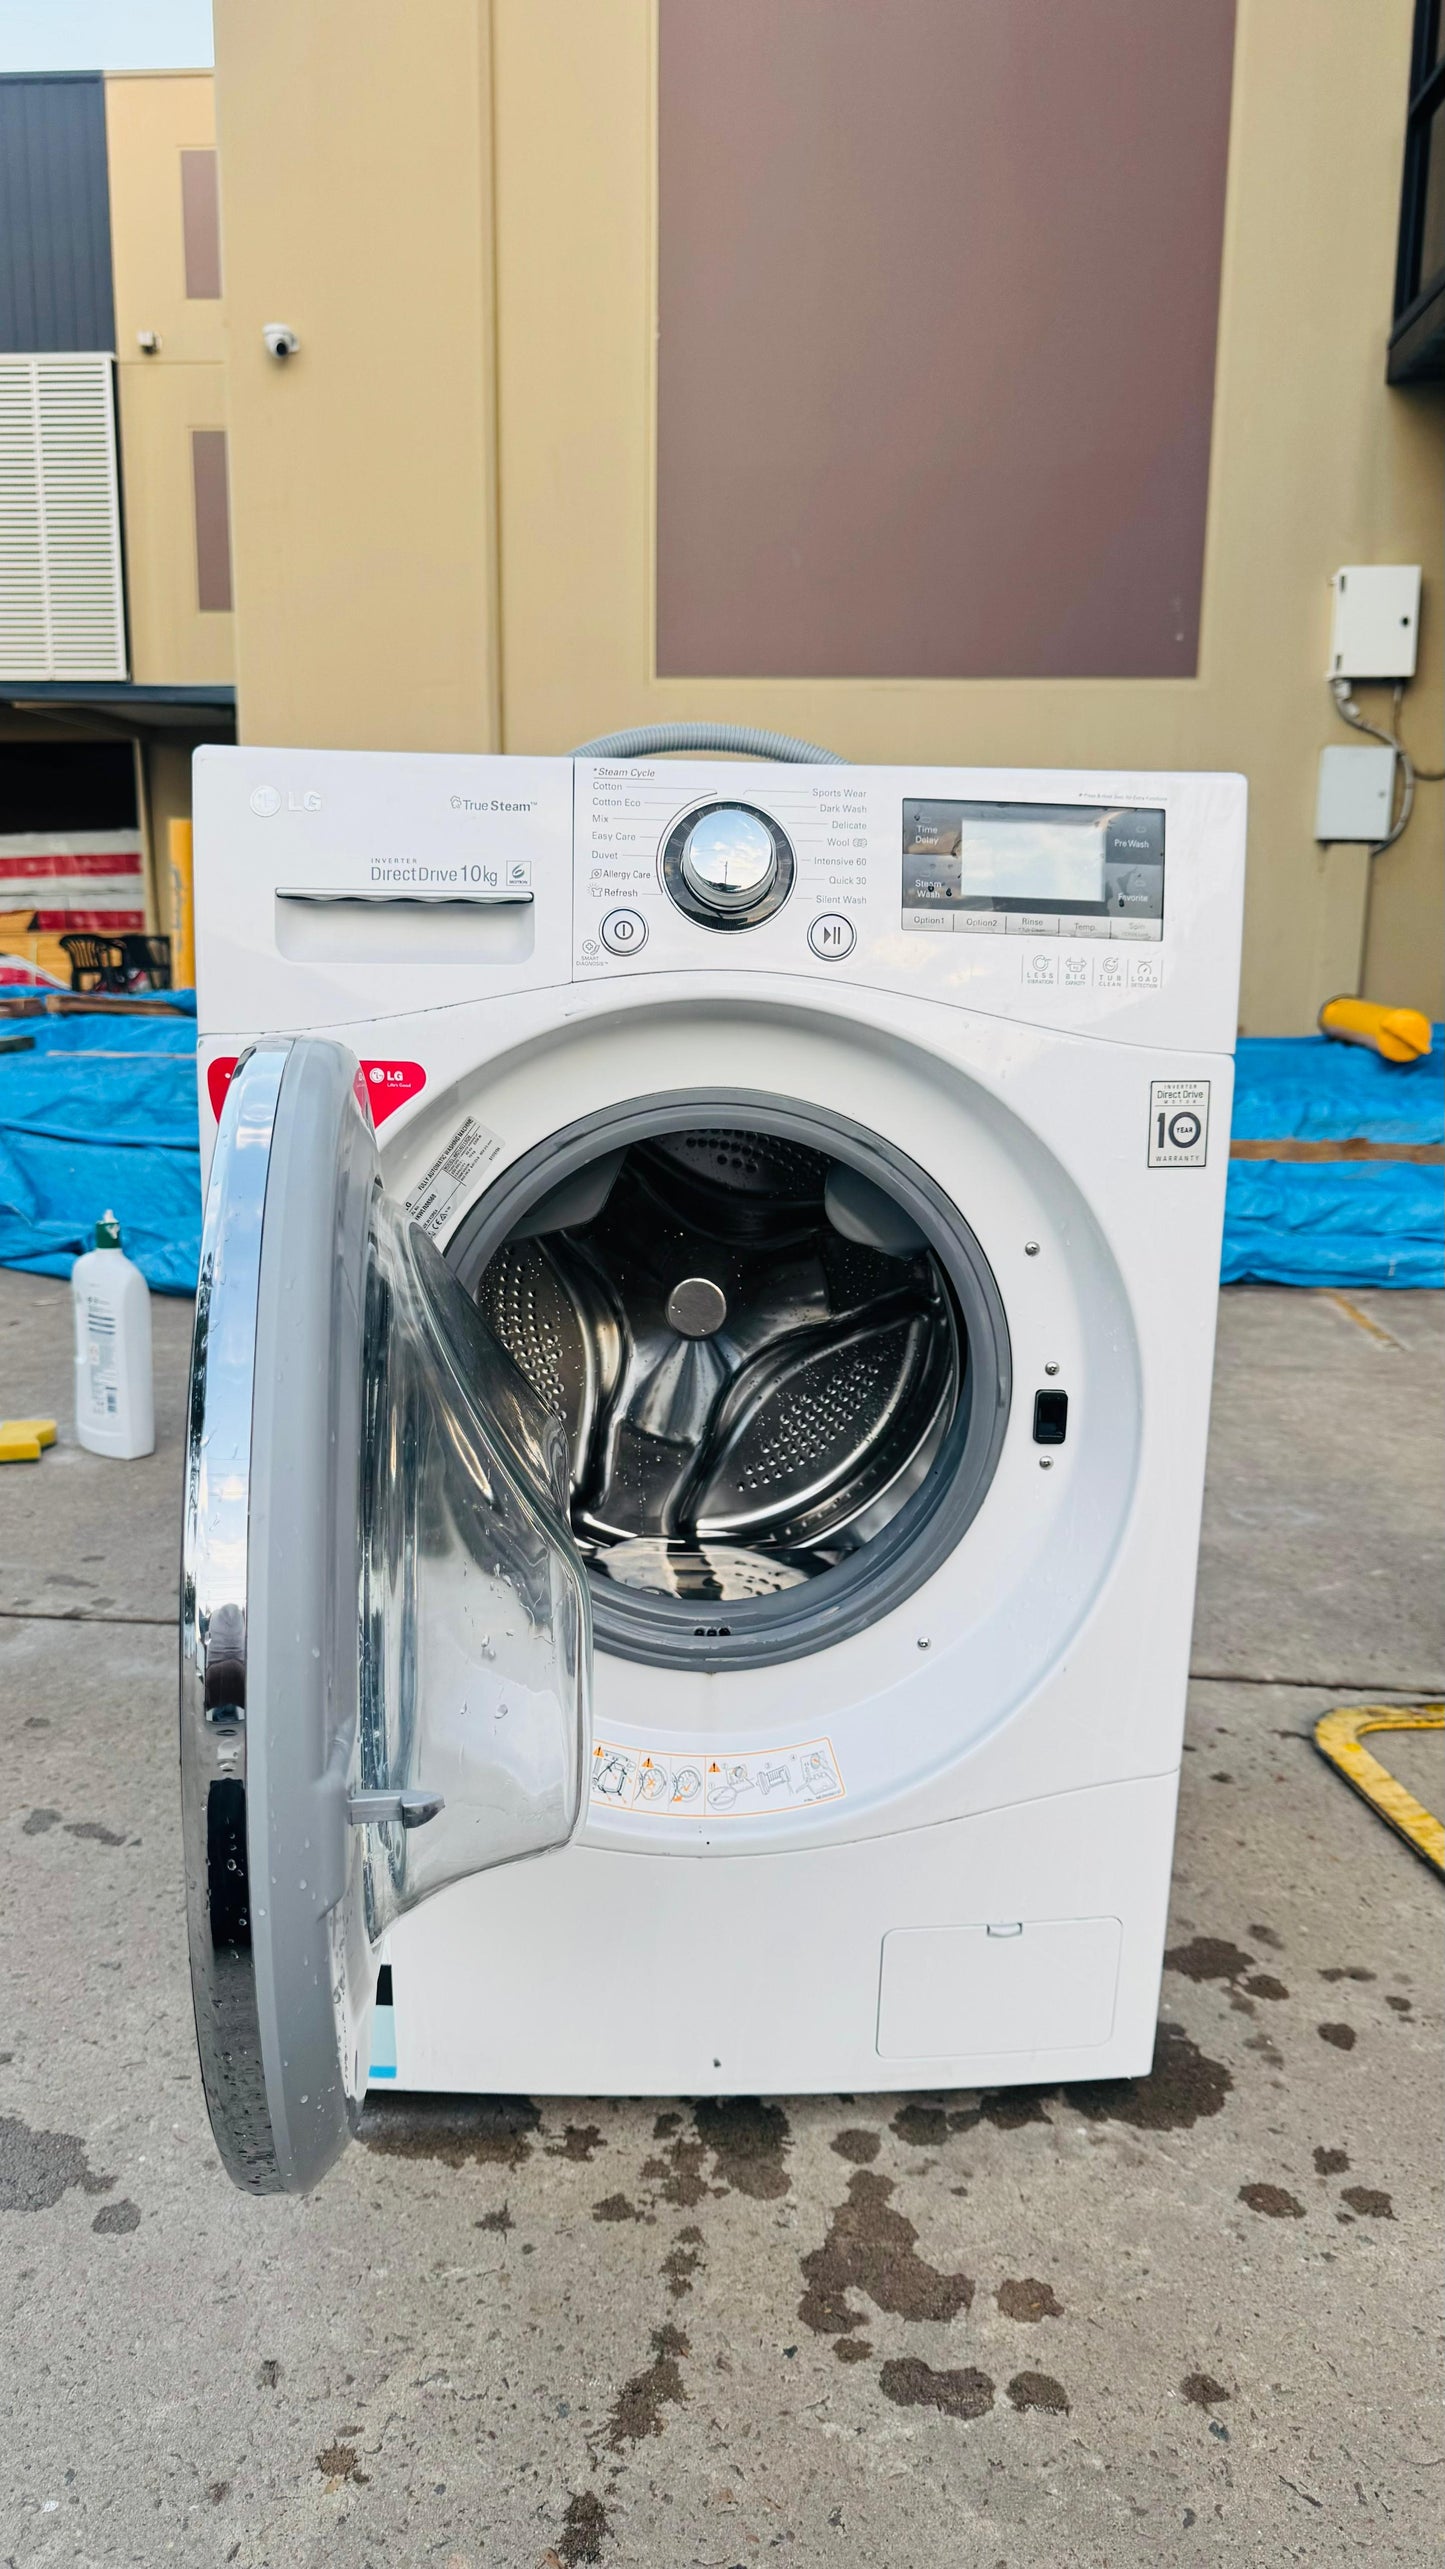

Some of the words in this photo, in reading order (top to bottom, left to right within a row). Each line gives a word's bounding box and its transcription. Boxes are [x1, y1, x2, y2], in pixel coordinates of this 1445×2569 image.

[630, 768, 656, 778] Cycle
[592, 782, 623, 790] Cotton
[812, 788, 841, 798] Sports
[843, 789, 867, 798] Wear
[288, 791, 321, 812] LG
[592, 797, 622, 806] Cotton
[624, 798, 641, 806] Eco
[820, 804, 840, 812] Dark
[842, 805, 867, 813] Wash
[592, 814, 609, 823] Mix
[832, 820, 867, 830] Delicate
[916, 825, 938, 834] Time
[592, 832, 612, 841] Easy
[615, 832, 636, 840] Care
[915, 836, 939, 845] Delay
[827, 838, 850, 846] Wool
[1114, 839, 1128, 848] Pre
[1128, 840, 1150, 848] Wash
[592, 850, 618, 860] Duvet
[814, 857, 854, 866] Intensive
[856, 858, 867, 866] 60
[603, 870, 631, 880] Allergy
[632, 870, 651, 878] Care
[828, 876, 854, 884] Quick
[856, 876, 867, 885] 30
[915, 880, 942, 888] Steam
[604, 888, 638, 897] Refresh
[916, 890, 940, 898] Wash
[816, 894, 840, 904] Silent
[843, 896, 867, 904] Wash
[1118, 893, 1148, 902] Favorite
[914, 916, 944, 925] Option1
[966, 918, 998, 927] Option2
[1022, 918, 1044, 926] Rinse
[386, 1070, 404, 1081] LG
[1157, 1090, 1182, 1098] Direct
[1157, 1111, 1201, 1148] 10
